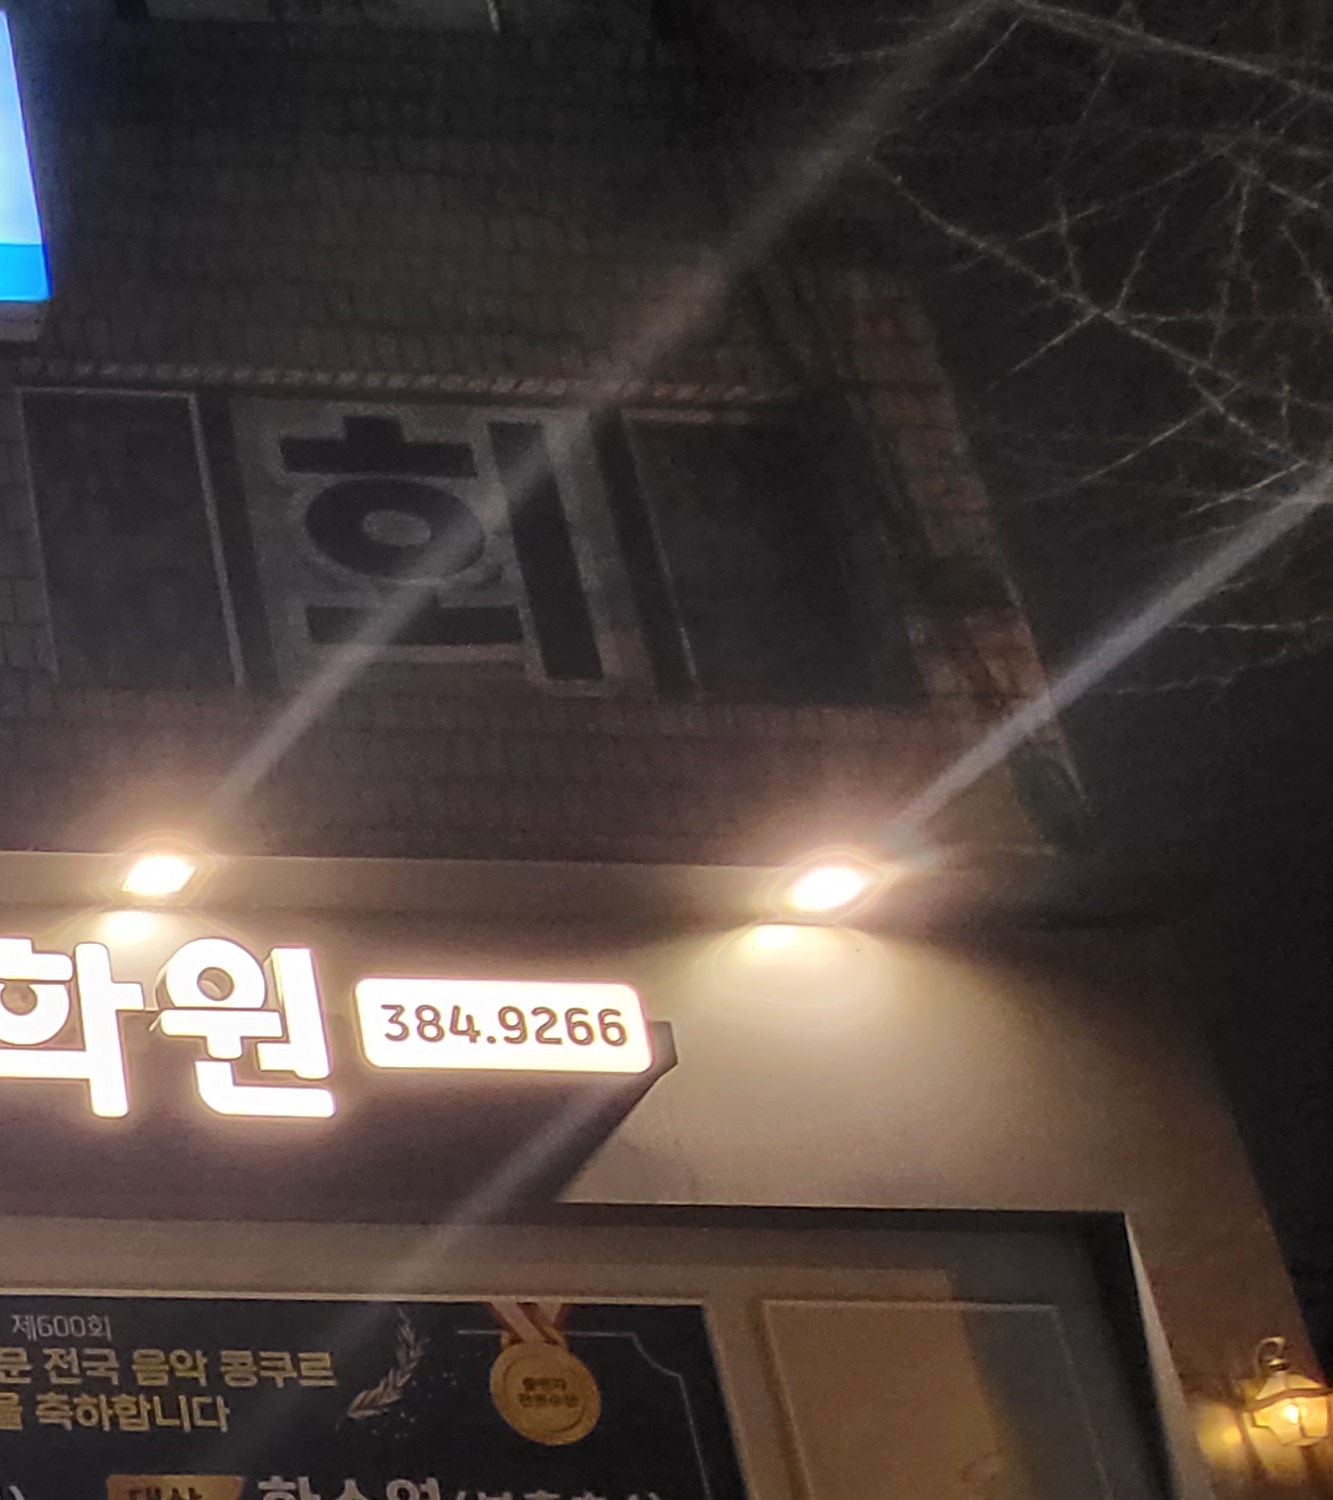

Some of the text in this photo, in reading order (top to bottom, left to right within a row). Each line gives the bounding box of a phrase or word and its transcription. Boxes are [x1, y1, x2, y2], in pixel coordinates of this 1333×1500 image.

[380, 1003, 629, 1048] 384.9266
[11, 1313, 113, 1342] 제600회
[42, 1346, 120, 1386] 전국
[132, 1348, 208, 1388] 음악
[220, 1349, 338, 1389] 콩쿠르
[35, 1392, 231, 1433] 축하합니다
